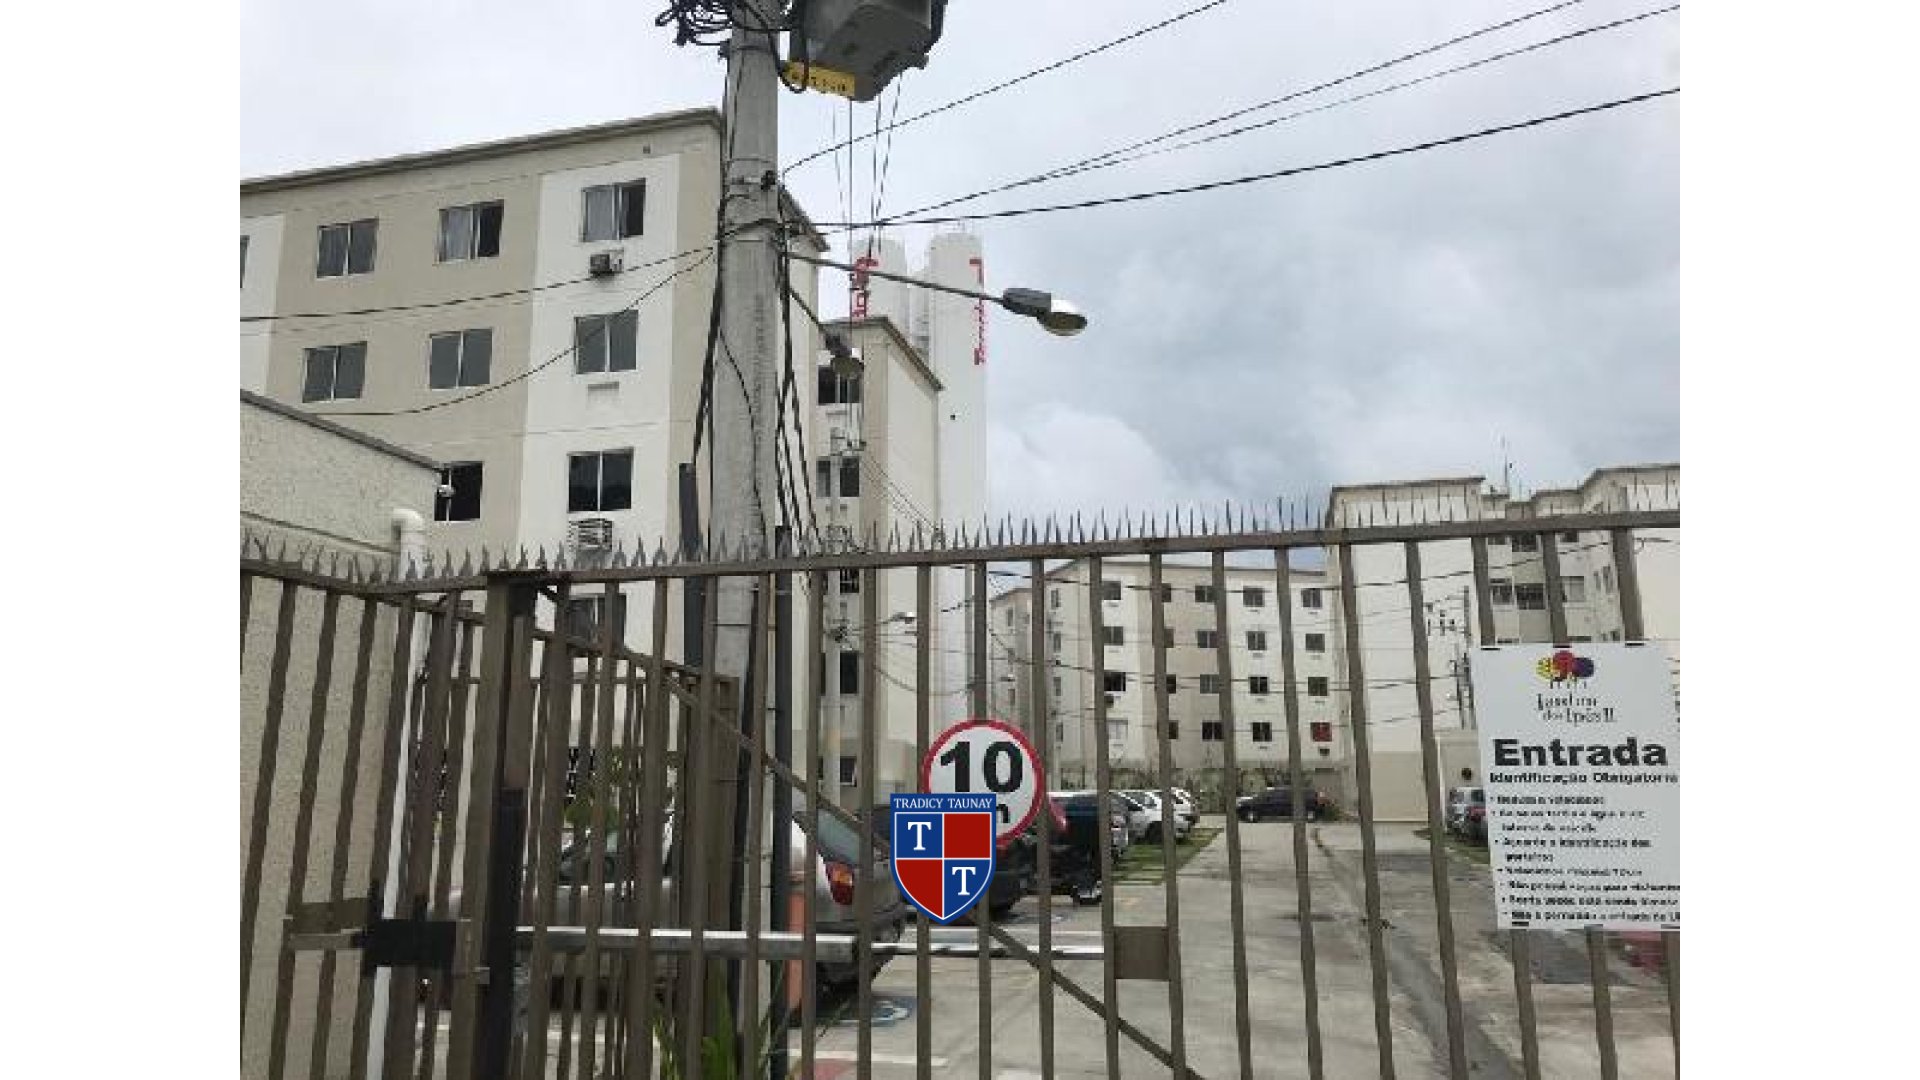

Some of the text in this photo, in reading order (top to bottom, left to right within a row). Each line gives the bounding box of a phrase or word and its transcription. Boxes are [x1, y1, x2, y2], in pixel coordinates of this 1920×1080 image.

[1493, 737, 1668, 766] Entrada
[940, 741, 1023, 793] 10
[1489, 773, 1587, 785] Identificação
